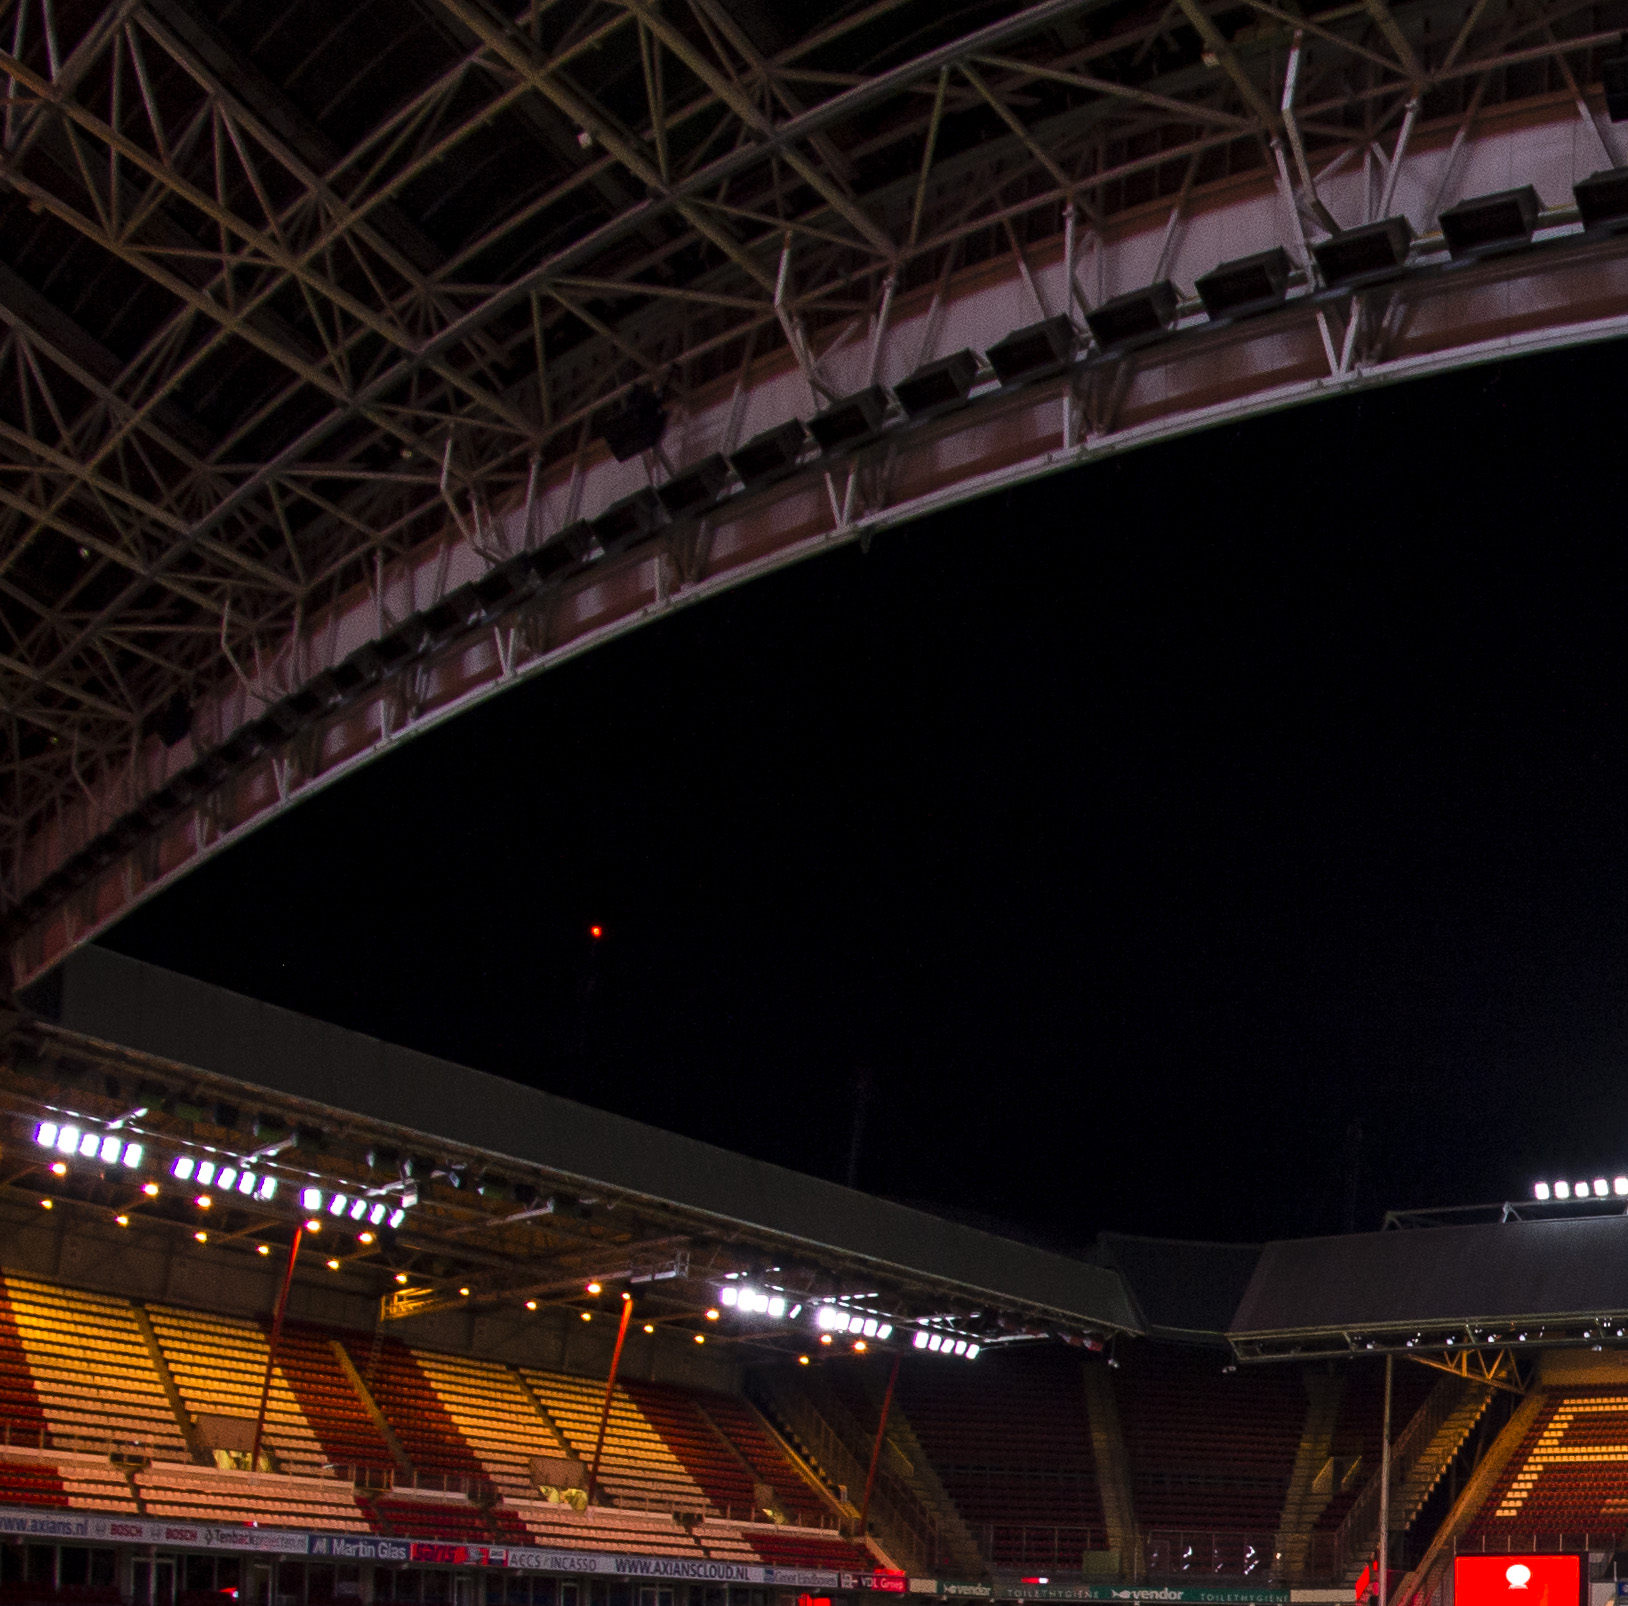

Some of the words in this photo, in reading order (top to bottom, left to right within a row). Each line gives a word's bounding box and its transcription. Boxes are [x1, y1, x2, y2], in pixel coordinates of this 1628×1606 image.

[333, 1538, 376, 1557] Martin
[378, 1543, 406, 1559] Glas
[550, 1556, 597, 1571] INCASSO
[615, 1558, 750, 1580] WWW.AXIANSCLOUD.NL
[1131, 1587, 1184, 1600] vendor
